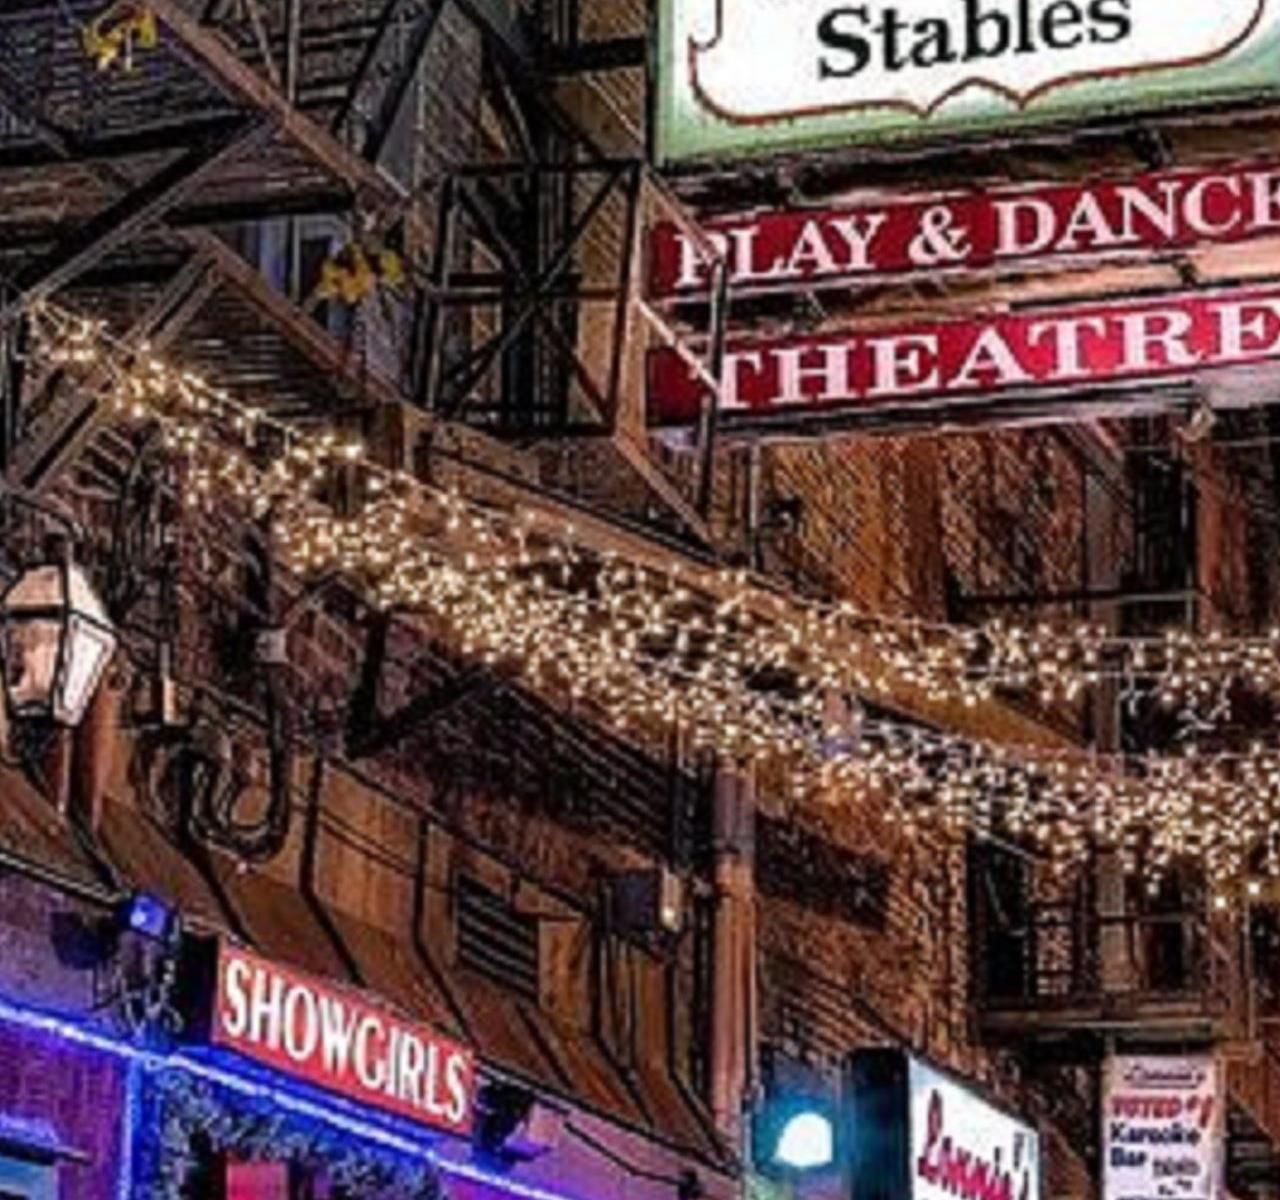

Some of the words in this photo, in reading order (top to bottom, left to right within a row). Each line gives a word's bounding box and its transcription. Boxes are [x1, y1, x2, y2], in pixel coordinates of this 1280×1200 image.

[818, 0, 1132, 80] Stables
[673, 213, 885, 290] PLAY
[908, 205, 972, 265] &
[223, 958, 468, 1123] SHOWGIRLS
[1110, 1147, 1147, 1167] Bar
